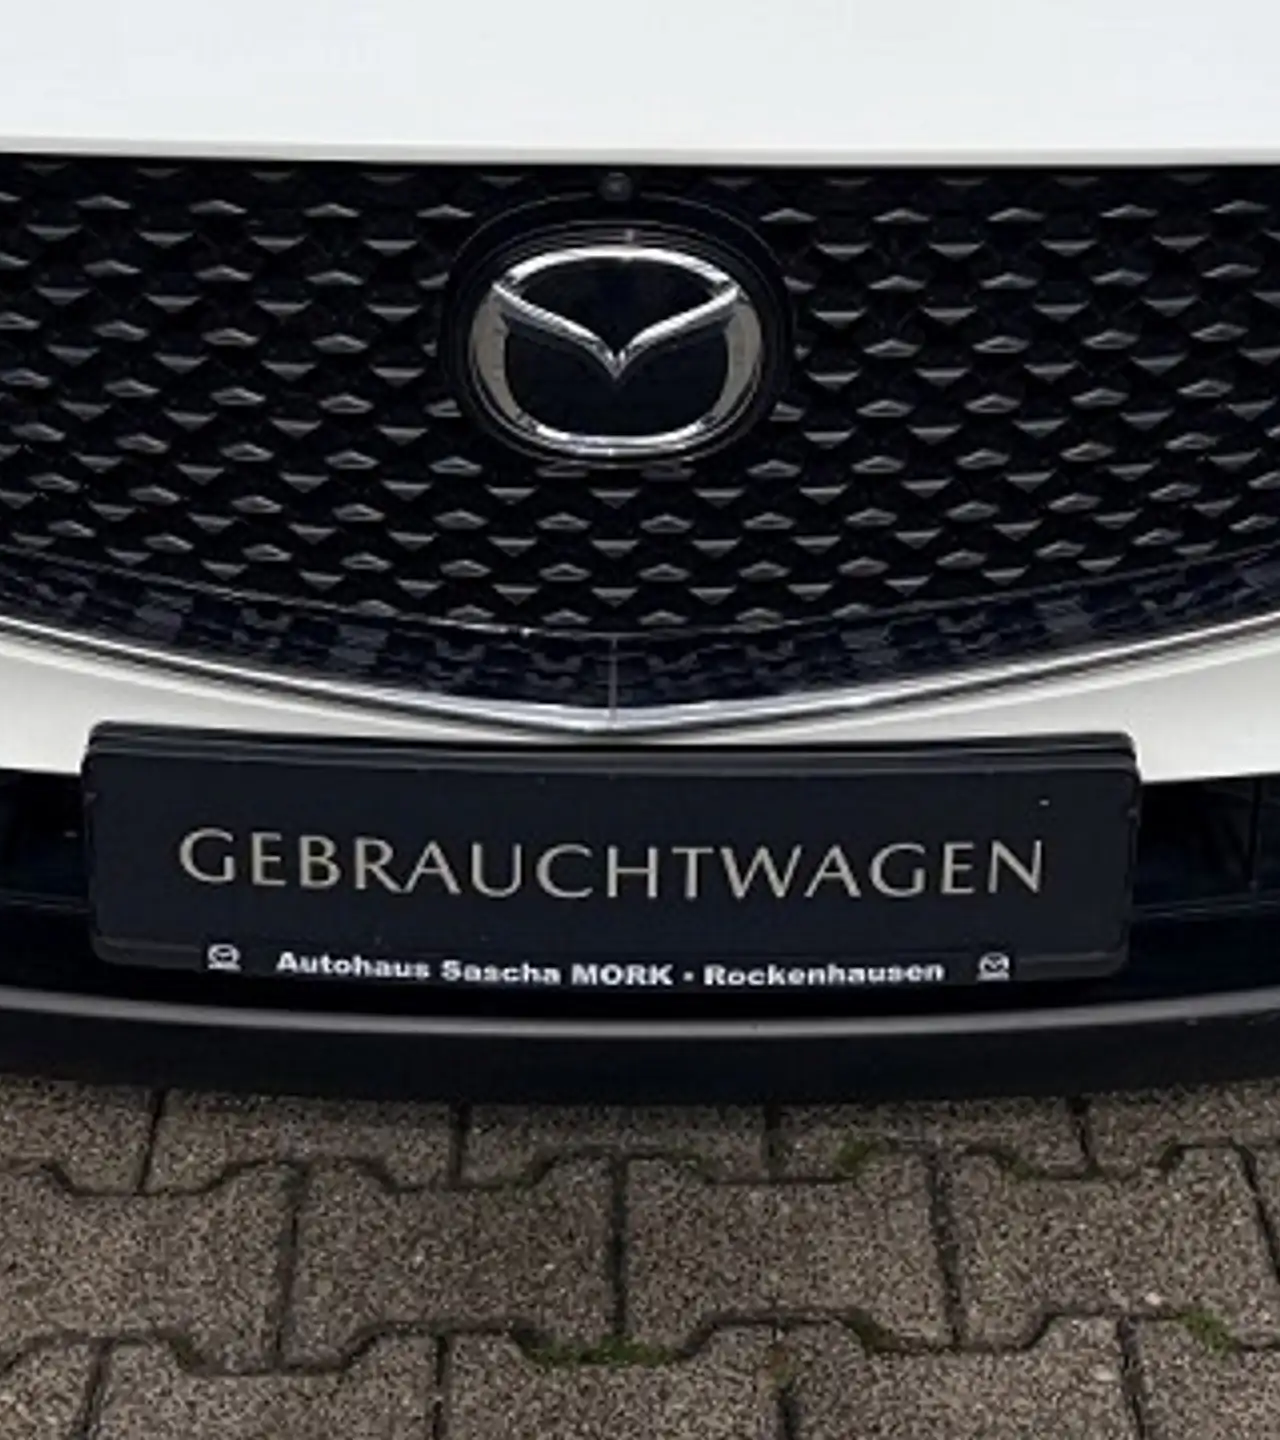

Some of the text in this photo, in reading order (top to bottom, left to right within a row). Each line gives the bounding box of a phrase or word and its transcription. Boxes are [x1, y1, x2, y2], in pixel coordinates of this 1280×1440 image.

[178, 827, 1045, 901] GEBRAUCHTWAGEN
[276, 951, 944, 987] Autohaus Sascha MORK Rockenhausen
